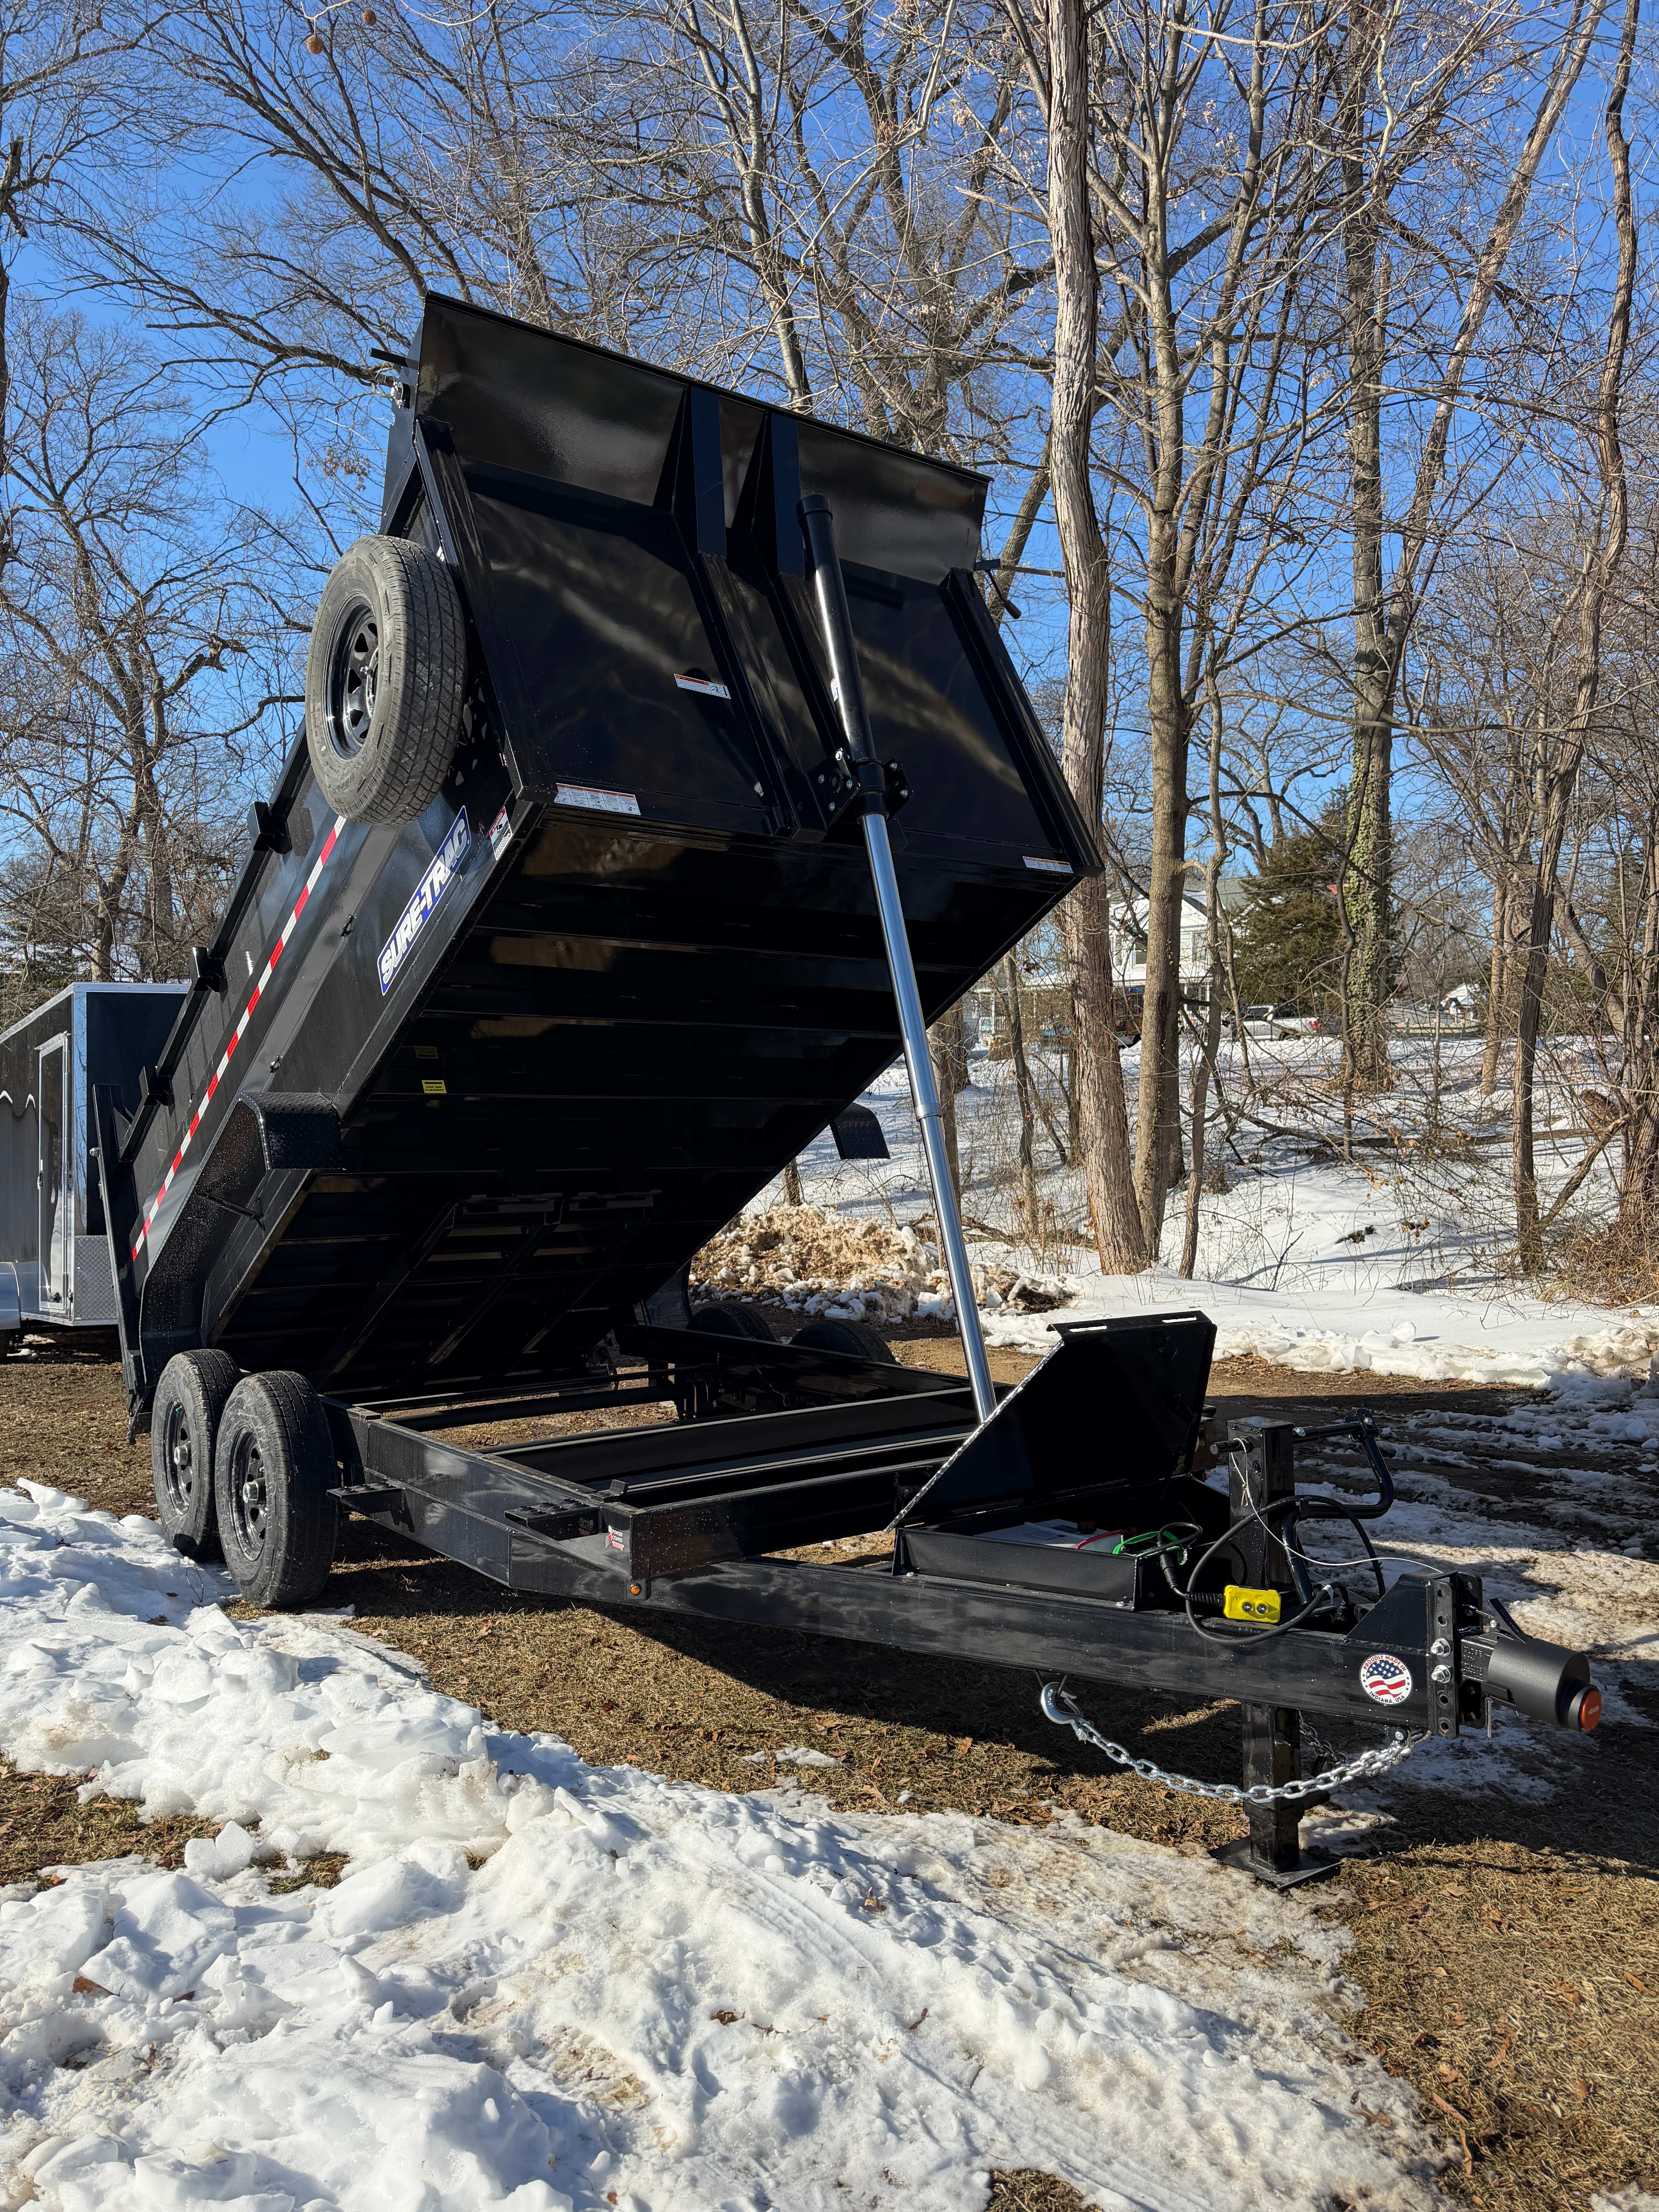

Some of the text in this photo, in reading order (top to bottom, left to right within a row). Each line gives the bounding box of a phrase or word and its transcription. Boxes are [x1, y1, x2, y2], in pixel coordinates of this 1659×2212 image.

[381, 818, 466, 984] SURE-TRAC
[1363, 1655, 1383, 1670] PROUDLY
[1385, 1655, 1401, 1665] MADE
[1588, 1705, 1599, 1715] VEVOR
